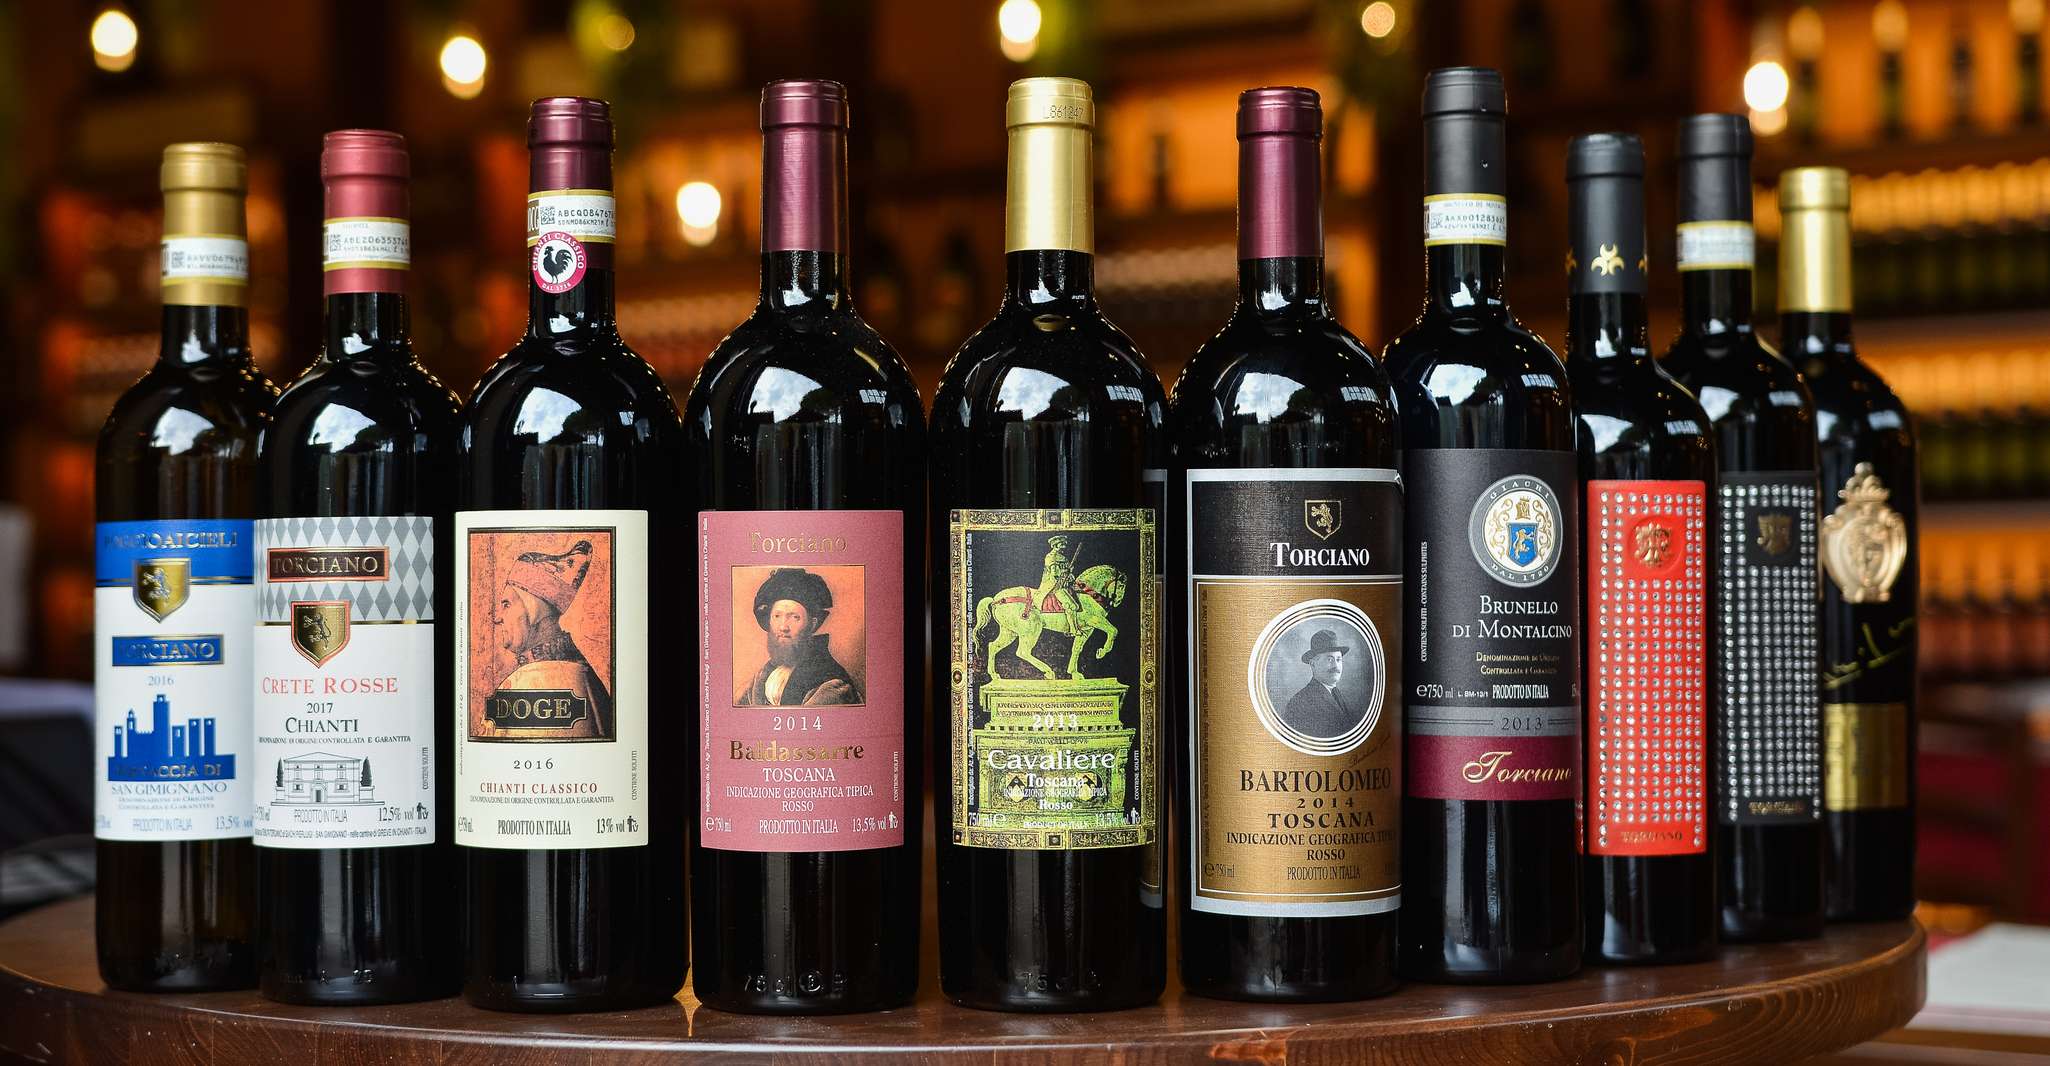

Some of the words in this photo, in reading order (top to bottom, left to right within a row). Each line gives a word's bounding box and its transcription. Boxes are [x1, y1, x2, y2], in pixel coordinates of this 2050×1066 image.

[533, 233, 551, 271] CHIANTI
[554, 232, 584, 269] CLASSICO
[1490, 480, 1550, 500] GIACHI
[751, 532, 847, 553] Torciano
[1270, 542, 1370, 567] TORCIANO
[1420, 541, 1428, 574] SULPHITES
[274, 556, 378, 574] TORCIANO
[1490, 563, 1515, 580] DAL
[1523, 565, 1549, 581] 1720
[1420, 574, 1428, 605] CONTAINS
[1480, 595, 1558, 615] BRUNELLO
[1420, 607, 1428, 630] SOLFITI
[1452, 625, 1470, 638] DI
[1478, 620, 1572, 638] MONTALCINO
[1420, 631, 1428, 662] CONTIENE
[1476, 652, 1529, 662] DENOMINAZIONE
[1481, 665, 1524, 675] CONTROLLATA
[148, 675, 174, 686] 2016
[262, 677, 314, 694] CRETE
[324, 677, 398, 694] ROSSE
[1445, 687, 1453, 699] ml
[1492, 684, 1525, 699] PRODOTTO
[1525, 684, 1532, 699] IN
[1532, 684, 1549, 699] ITALIA
[306, 702, 333, 713] 2017
[496, 698, 572, 720] DOGE
[285, 717, 359, 733] CHIANTI
[773, 716, 822, 731] 2014
[1032, 715, 1078, 728] 2013
[1501, 717, 1542, 731] 2013
[319, 736, 365, 744] CONTROLLATA
[367, 736, 373, 744] E
[374, 735, 411, 743] GARANTITA
[730, 740, 864, 761] Baldassarre
[513, 758, 554, 770] 2016
[987, 750, 1115, 770] Cavaliere
[1462, 750, 1572, 784] Torciano
[204, 764, 222, 776] DI
[762, 767, 836, 782] TOSCANA
[1027, 773, 1085, 788] Toscana
[1239, 768, 1391, 792] BARTOLOMEO
[112, 785, 133, 796] SAN
[135, 782, 227, 795] GIMIGNANO
[480, 783, 526, 794] CHIANTI
[531, 782, 598, 794] CLASSICO
[726, 786, 780, 799] INDICAZIONE
[783, 786, 844, 799] GEOGRAFICA
[846, 785, 873, 797] TIPICA
[581, 796, 614, 804] GARANTITA
[782, 801, 814, 812] ROSSO
[1039, 800, 1073, 810] Rosso
[1296, 798, 1355, 808] 2014
[497, 819, 535, 835] PRODOTTO
[537, 820, 545, 835] IN
[546, 820, 571, 835] ITALIA
[596, 817, 613, 833] 13%
[616, 819, 625, 833] vol
[759, 819, 800, 834] PRODOTTO
[802, 820, 811, 833] IN
[812, 819, 838, 833] ITALIA
[852, 818, 876, 832] 13,5%
[878, 818, 886, 830] vol
[1268, 812, 1374, 829] TOSCANA
[1227, 832, 1304, 845] INDICAZIONE
[1309, 832, 1376, 845] GEOGRAFICA
[1307, 849, 1345, 861] ROSSO
[1287, 866, 1328, 881] PRODOTTO
[1330, 866, 1338, 880] IN
[1339, 866, 1360, 880] ITALIA
